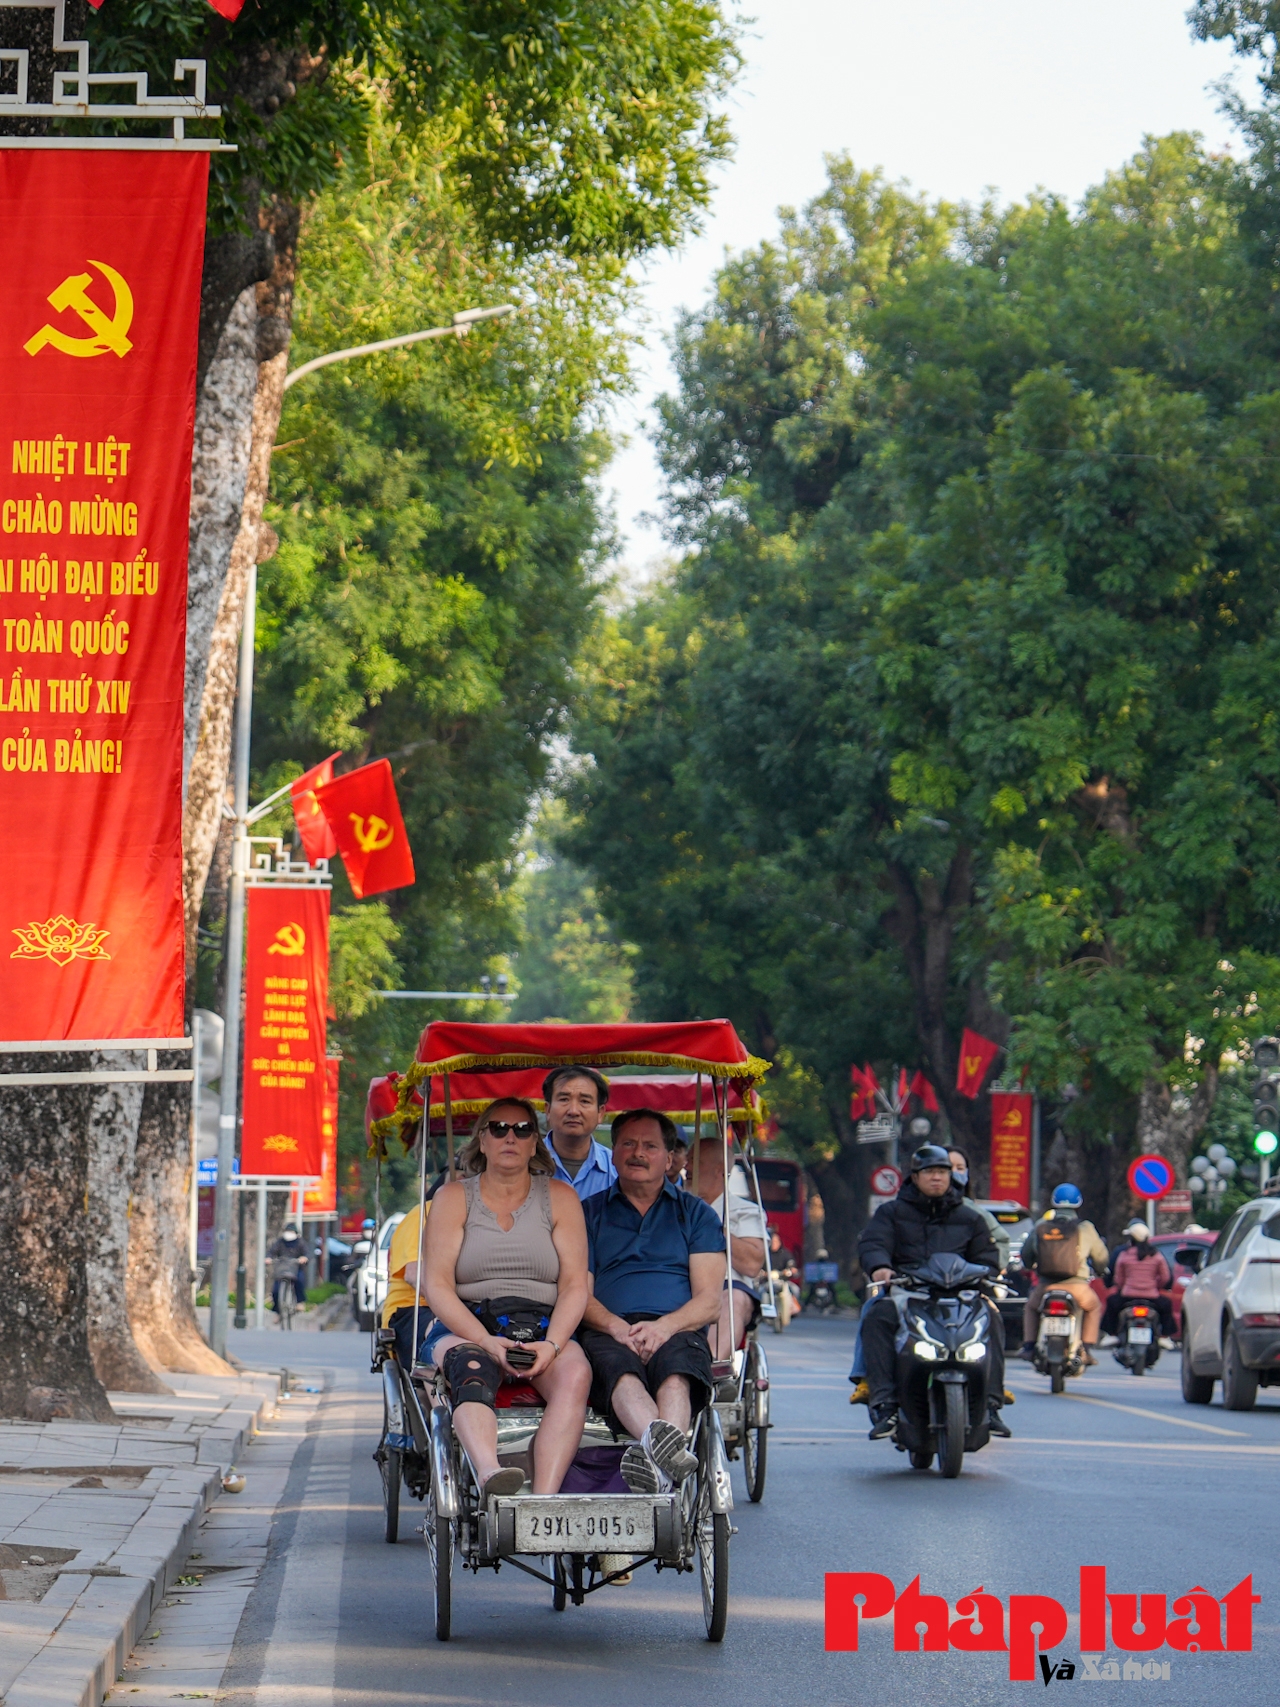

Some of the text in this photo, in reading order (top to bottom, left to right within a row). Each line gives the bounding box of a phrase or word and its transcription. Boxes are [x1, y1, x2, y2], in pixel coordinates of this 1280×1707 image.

[12, 433, 130, 483] NHIỆT LIỆT
[2, 492, 138, 536] CHÀO MỪNG
[20, 552, 58, 600] HỘI
[65, 560, 103, 602] ĐẠI
[110, 548, 159, 595] BIỂU
[4, 609, 129, 658] TOÀN QUỐC
[47, 673, 93, 714] THỨ
[96, 681, 130, 715] XIV
[2, 727, 122, 774] CỦA ĐẢNG!
[531, 1517, 635, 1536] 29XL-0056
